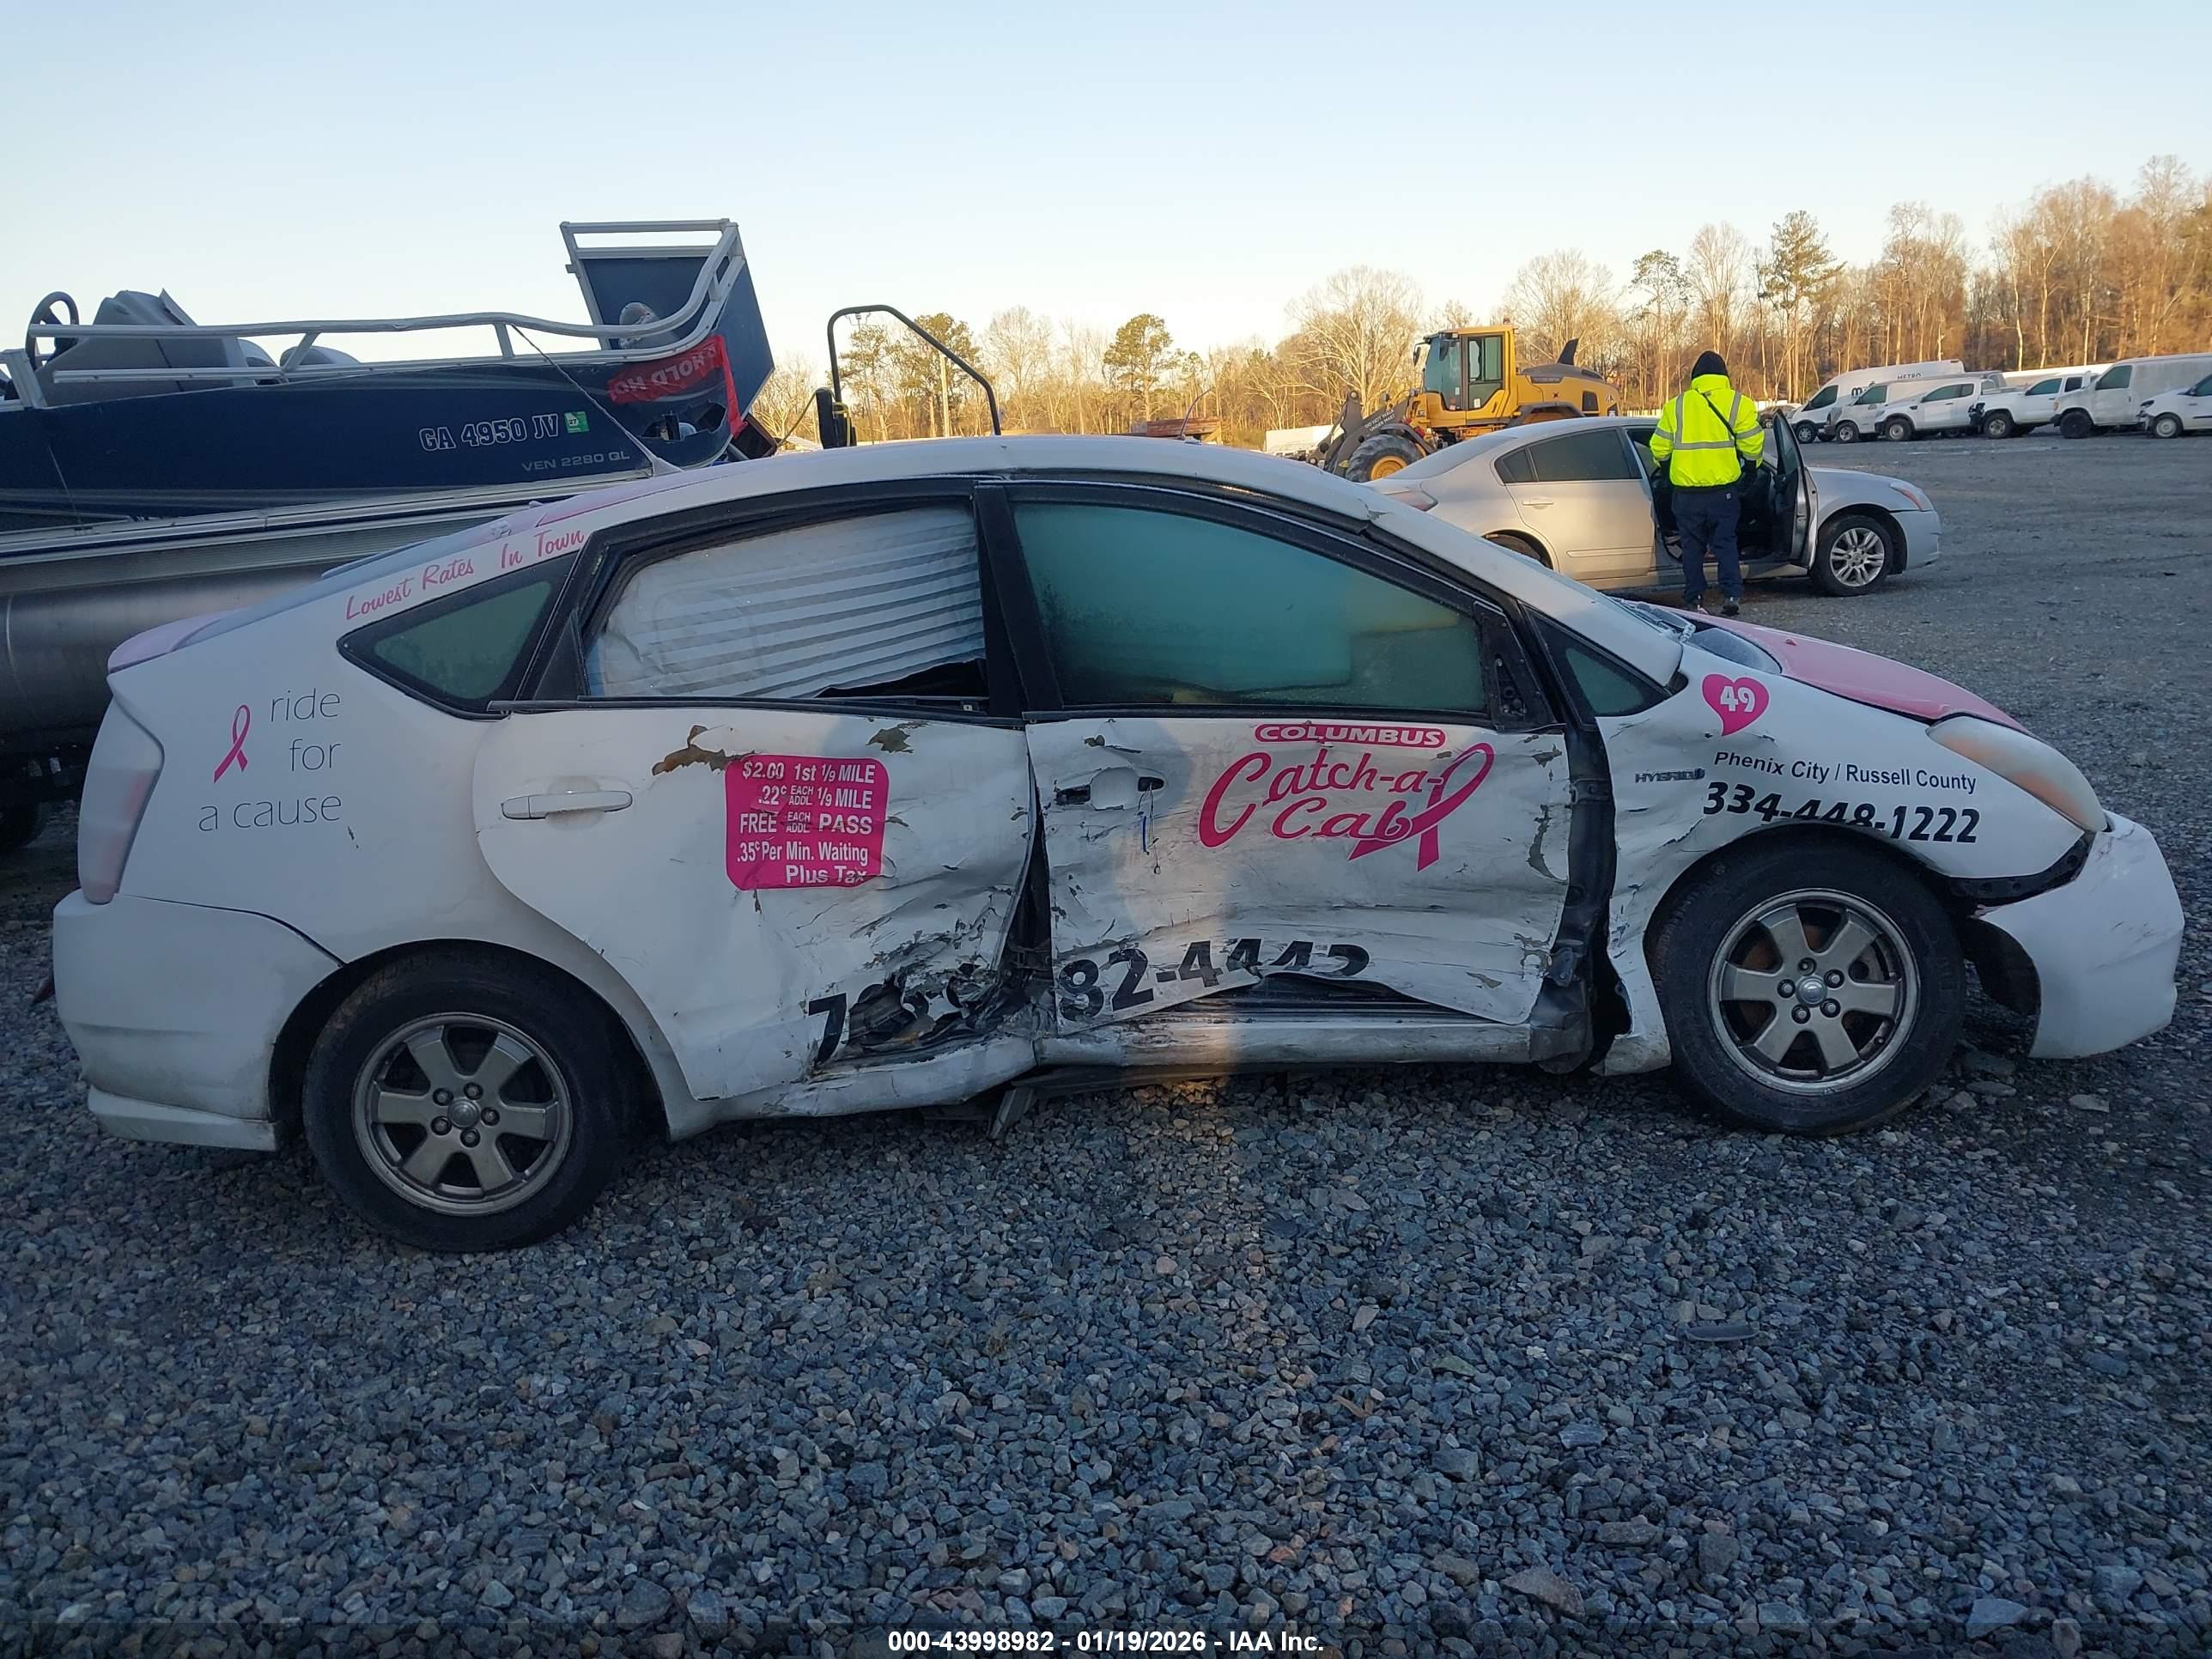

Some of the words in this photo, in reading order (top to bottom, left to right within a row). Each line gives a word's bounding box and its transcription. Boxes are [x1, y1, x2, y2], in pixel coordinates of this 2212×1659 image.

[419, 428, 456, 451] GA
[461, 418, 526, 446] 4950
[532, 414, 558, 439] JV
[522, 459, 556, 471] VEN
[561, 453, 604, 467] 2280
[346, 577, 414, 620] Lowest
[422, 558, 474, 590] Rates
[501, 544, 523, 568] In
[534, 529, 584, 557] Town
[270, 688, 341, 722] ride
[1720, 686, 1756, 713] 49
[1260, 726, 1442, 745] COLUMBUS
[289, 738, 341, 771] for
[742, 762, 785, 779] $2.00
[794, 763, 816, 781] 1st
[838, 765, 876, 784] MILE
[1715, 751, 1784, 776] Phenix
[1791, 761, 1830, 784] City
[1846, 764, 1911, 786] Russell
[1916, 770, 1976, 793] County
[791, 785, 814, 795] EACH
[836, 788, 872, 809] MILE
[199, 805, 218, 831] a
[234, 796, 342, 829] cause
[740, 812, 777, 834] FREE
[787, 811, 811, 822] EACH
[818, 813, 872, 835] PASS
[1272, 797, 1413, 840] Cab
[762, 842, 782, 860] Per
[786, 841, 814, 860] Min.
[818, 842, 868, 866] Waiting
[786, 865, 829, 884] Plus
[835, 866, 866, 884] Tax
